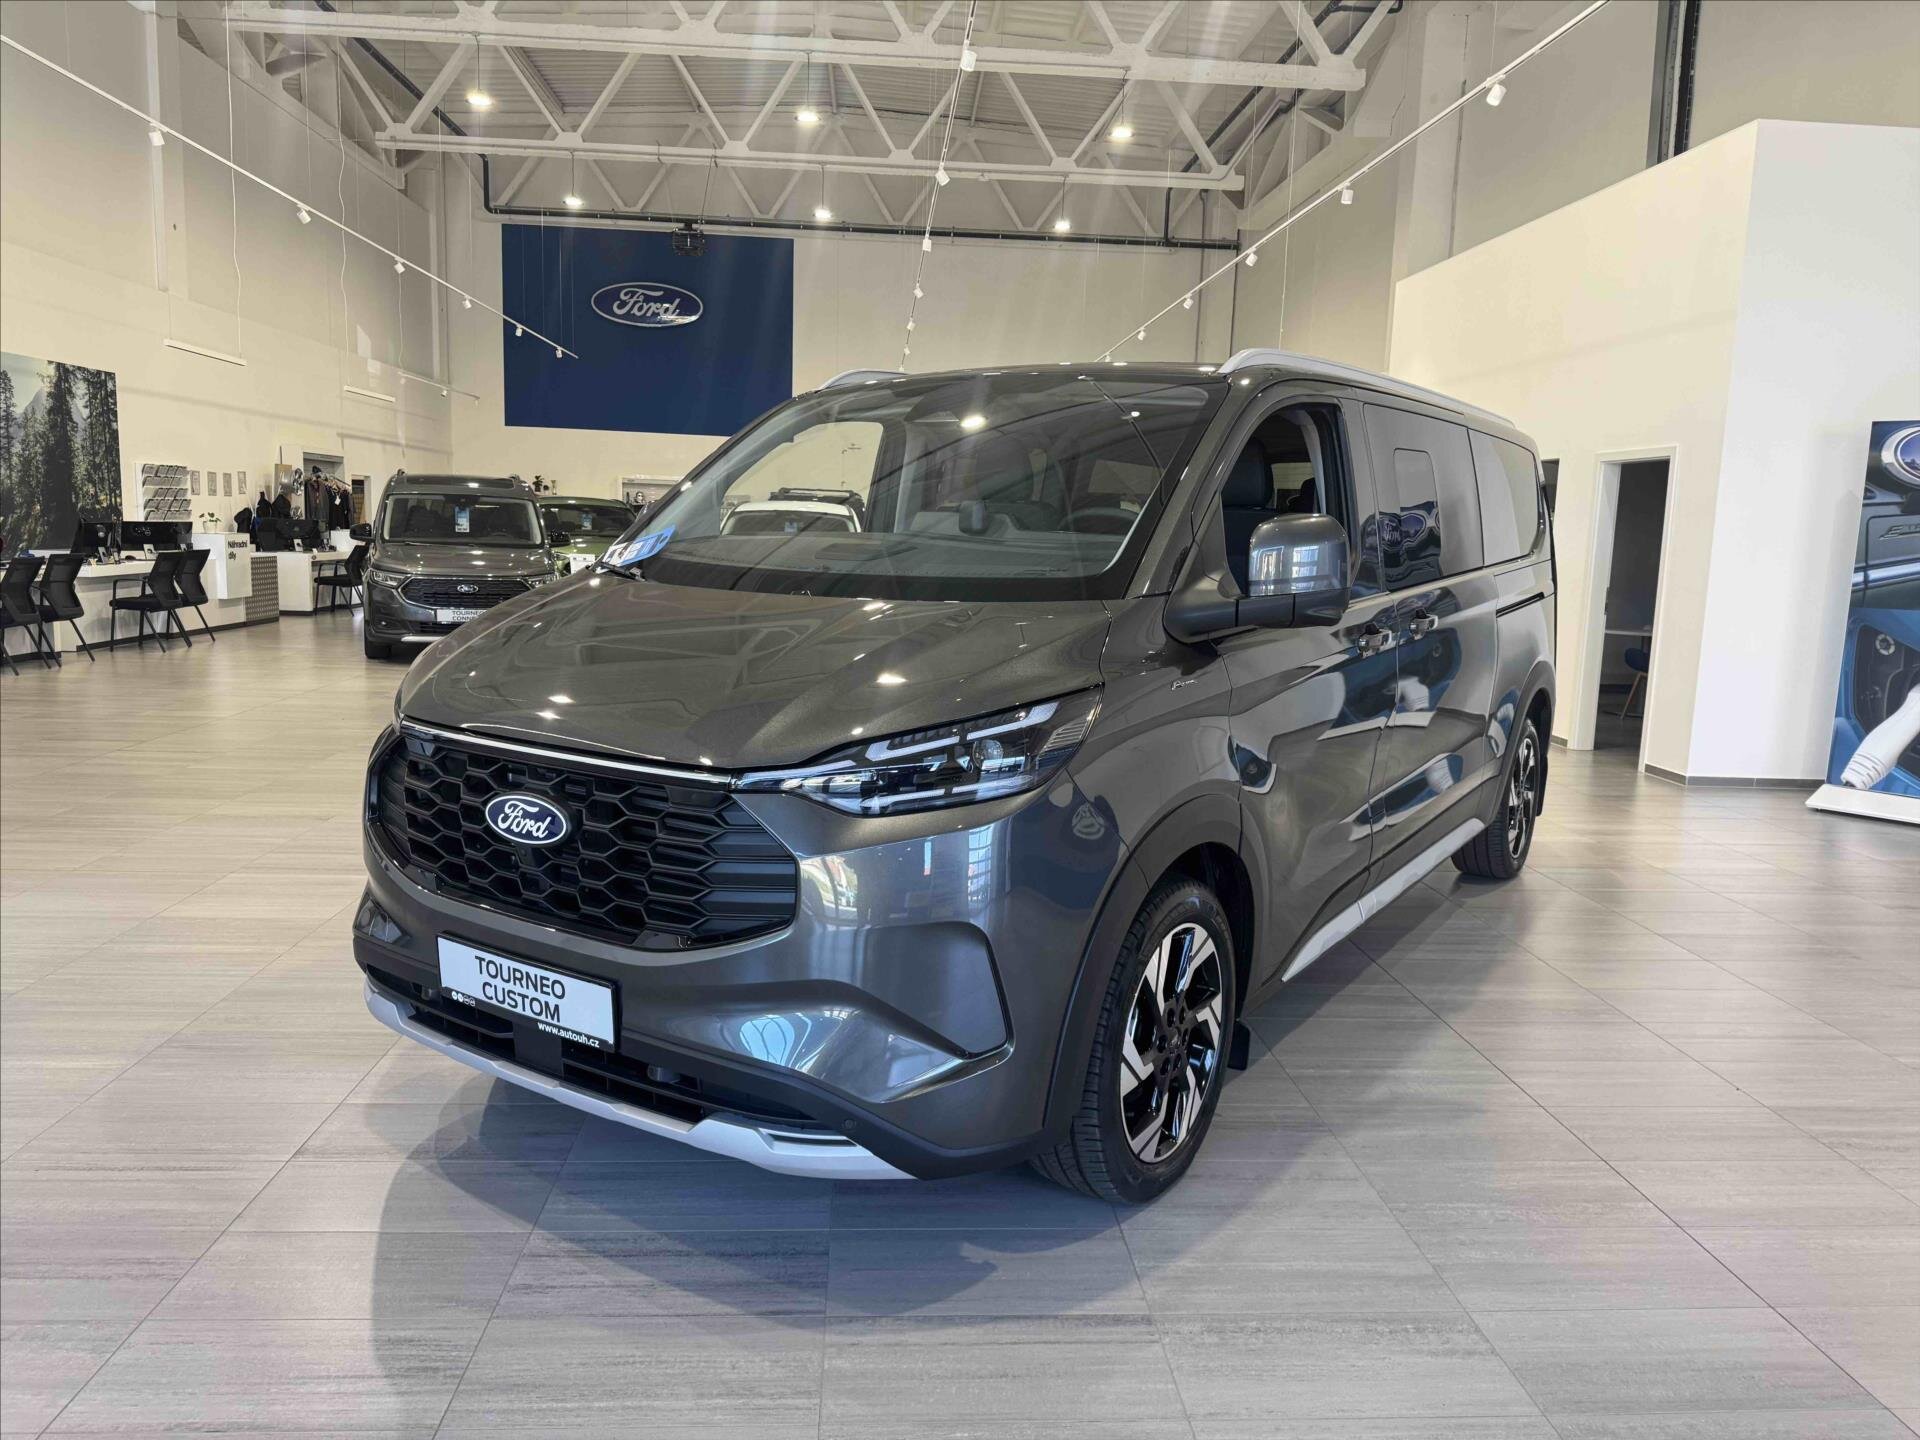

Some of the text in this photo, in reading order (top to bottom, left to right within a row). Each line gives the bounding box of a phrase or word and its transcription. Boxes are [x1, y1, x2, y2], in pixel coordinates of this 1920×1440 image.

[612, 287, 681, 317] Ford
[497, 800, 552, 839] Ford
[474, 955, 566, 1000] TOURNEO
[482, 981, 561, 1023] CUSTOM
[537, 1021, 600, 1049] www.autouh.cz
